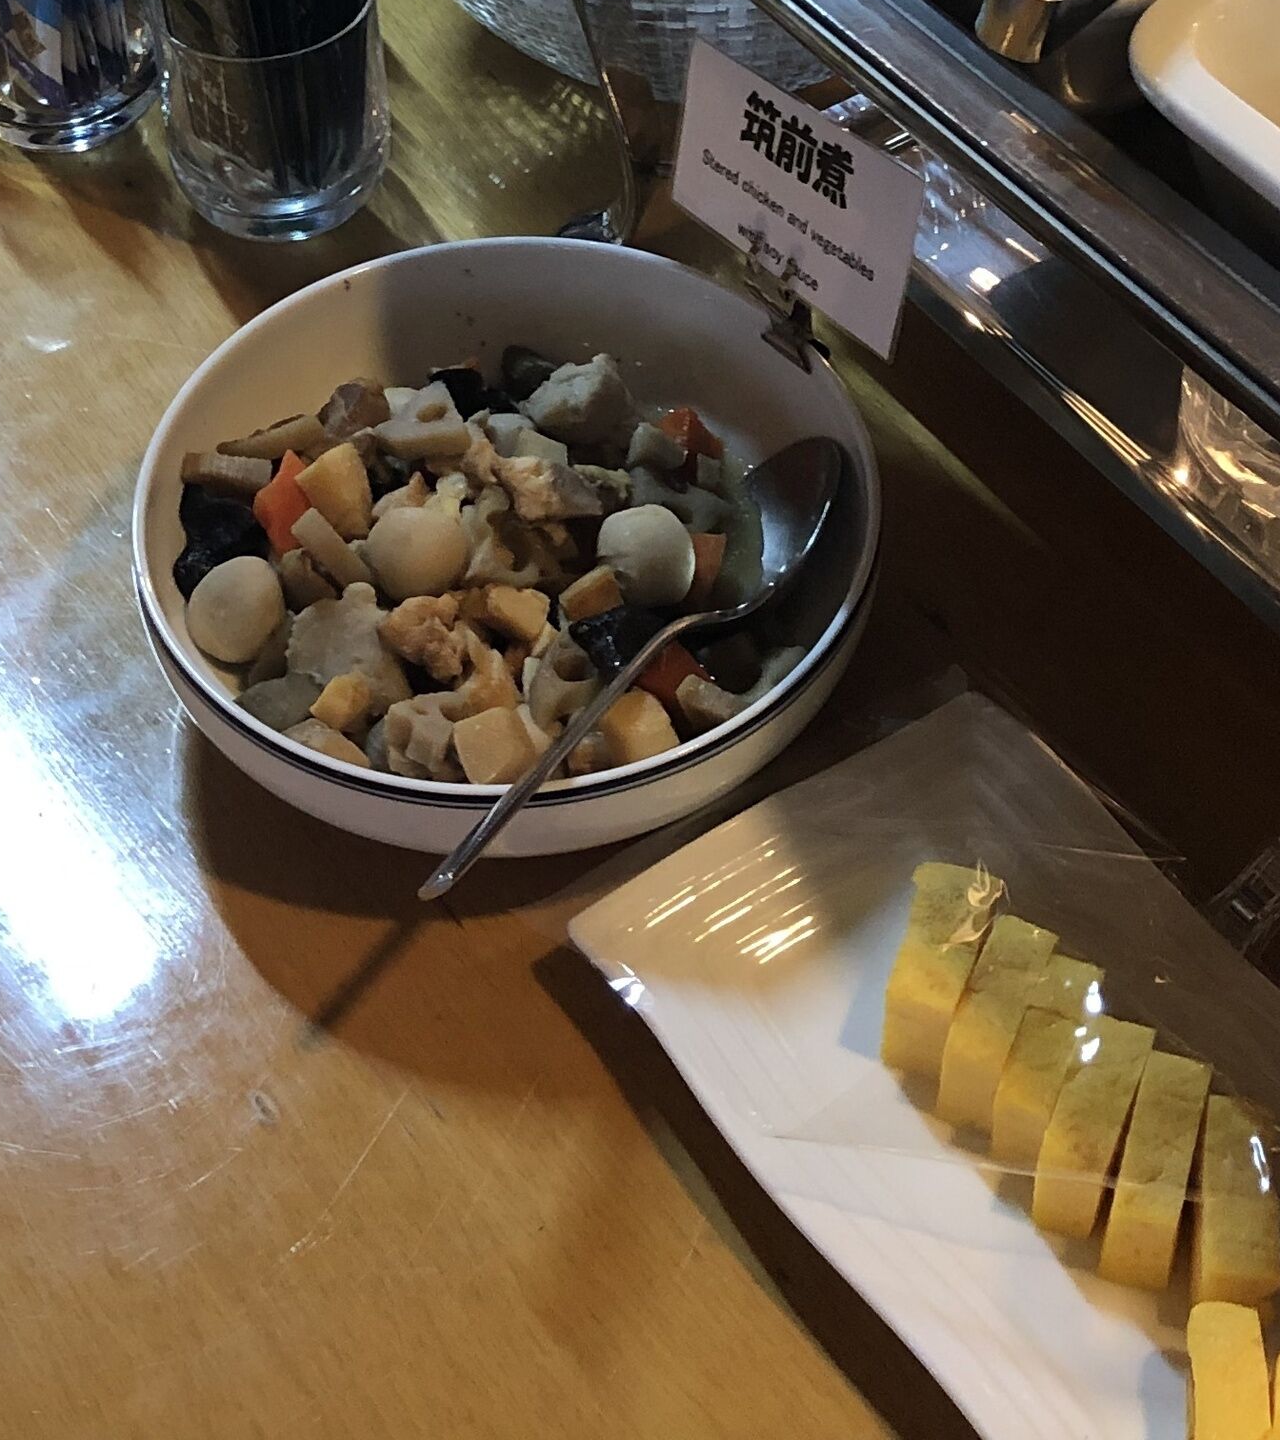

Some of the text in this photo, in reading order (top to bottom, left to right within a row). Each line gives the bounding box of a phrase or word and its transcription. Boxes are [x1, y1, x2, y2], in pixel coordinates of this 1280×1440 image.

[740, 90, 855, 209] 筑前煮
[741, 179, 785, 217] chicken
[787, 212, 810, 235] and
[810, 228, 875, 282] vegetables
